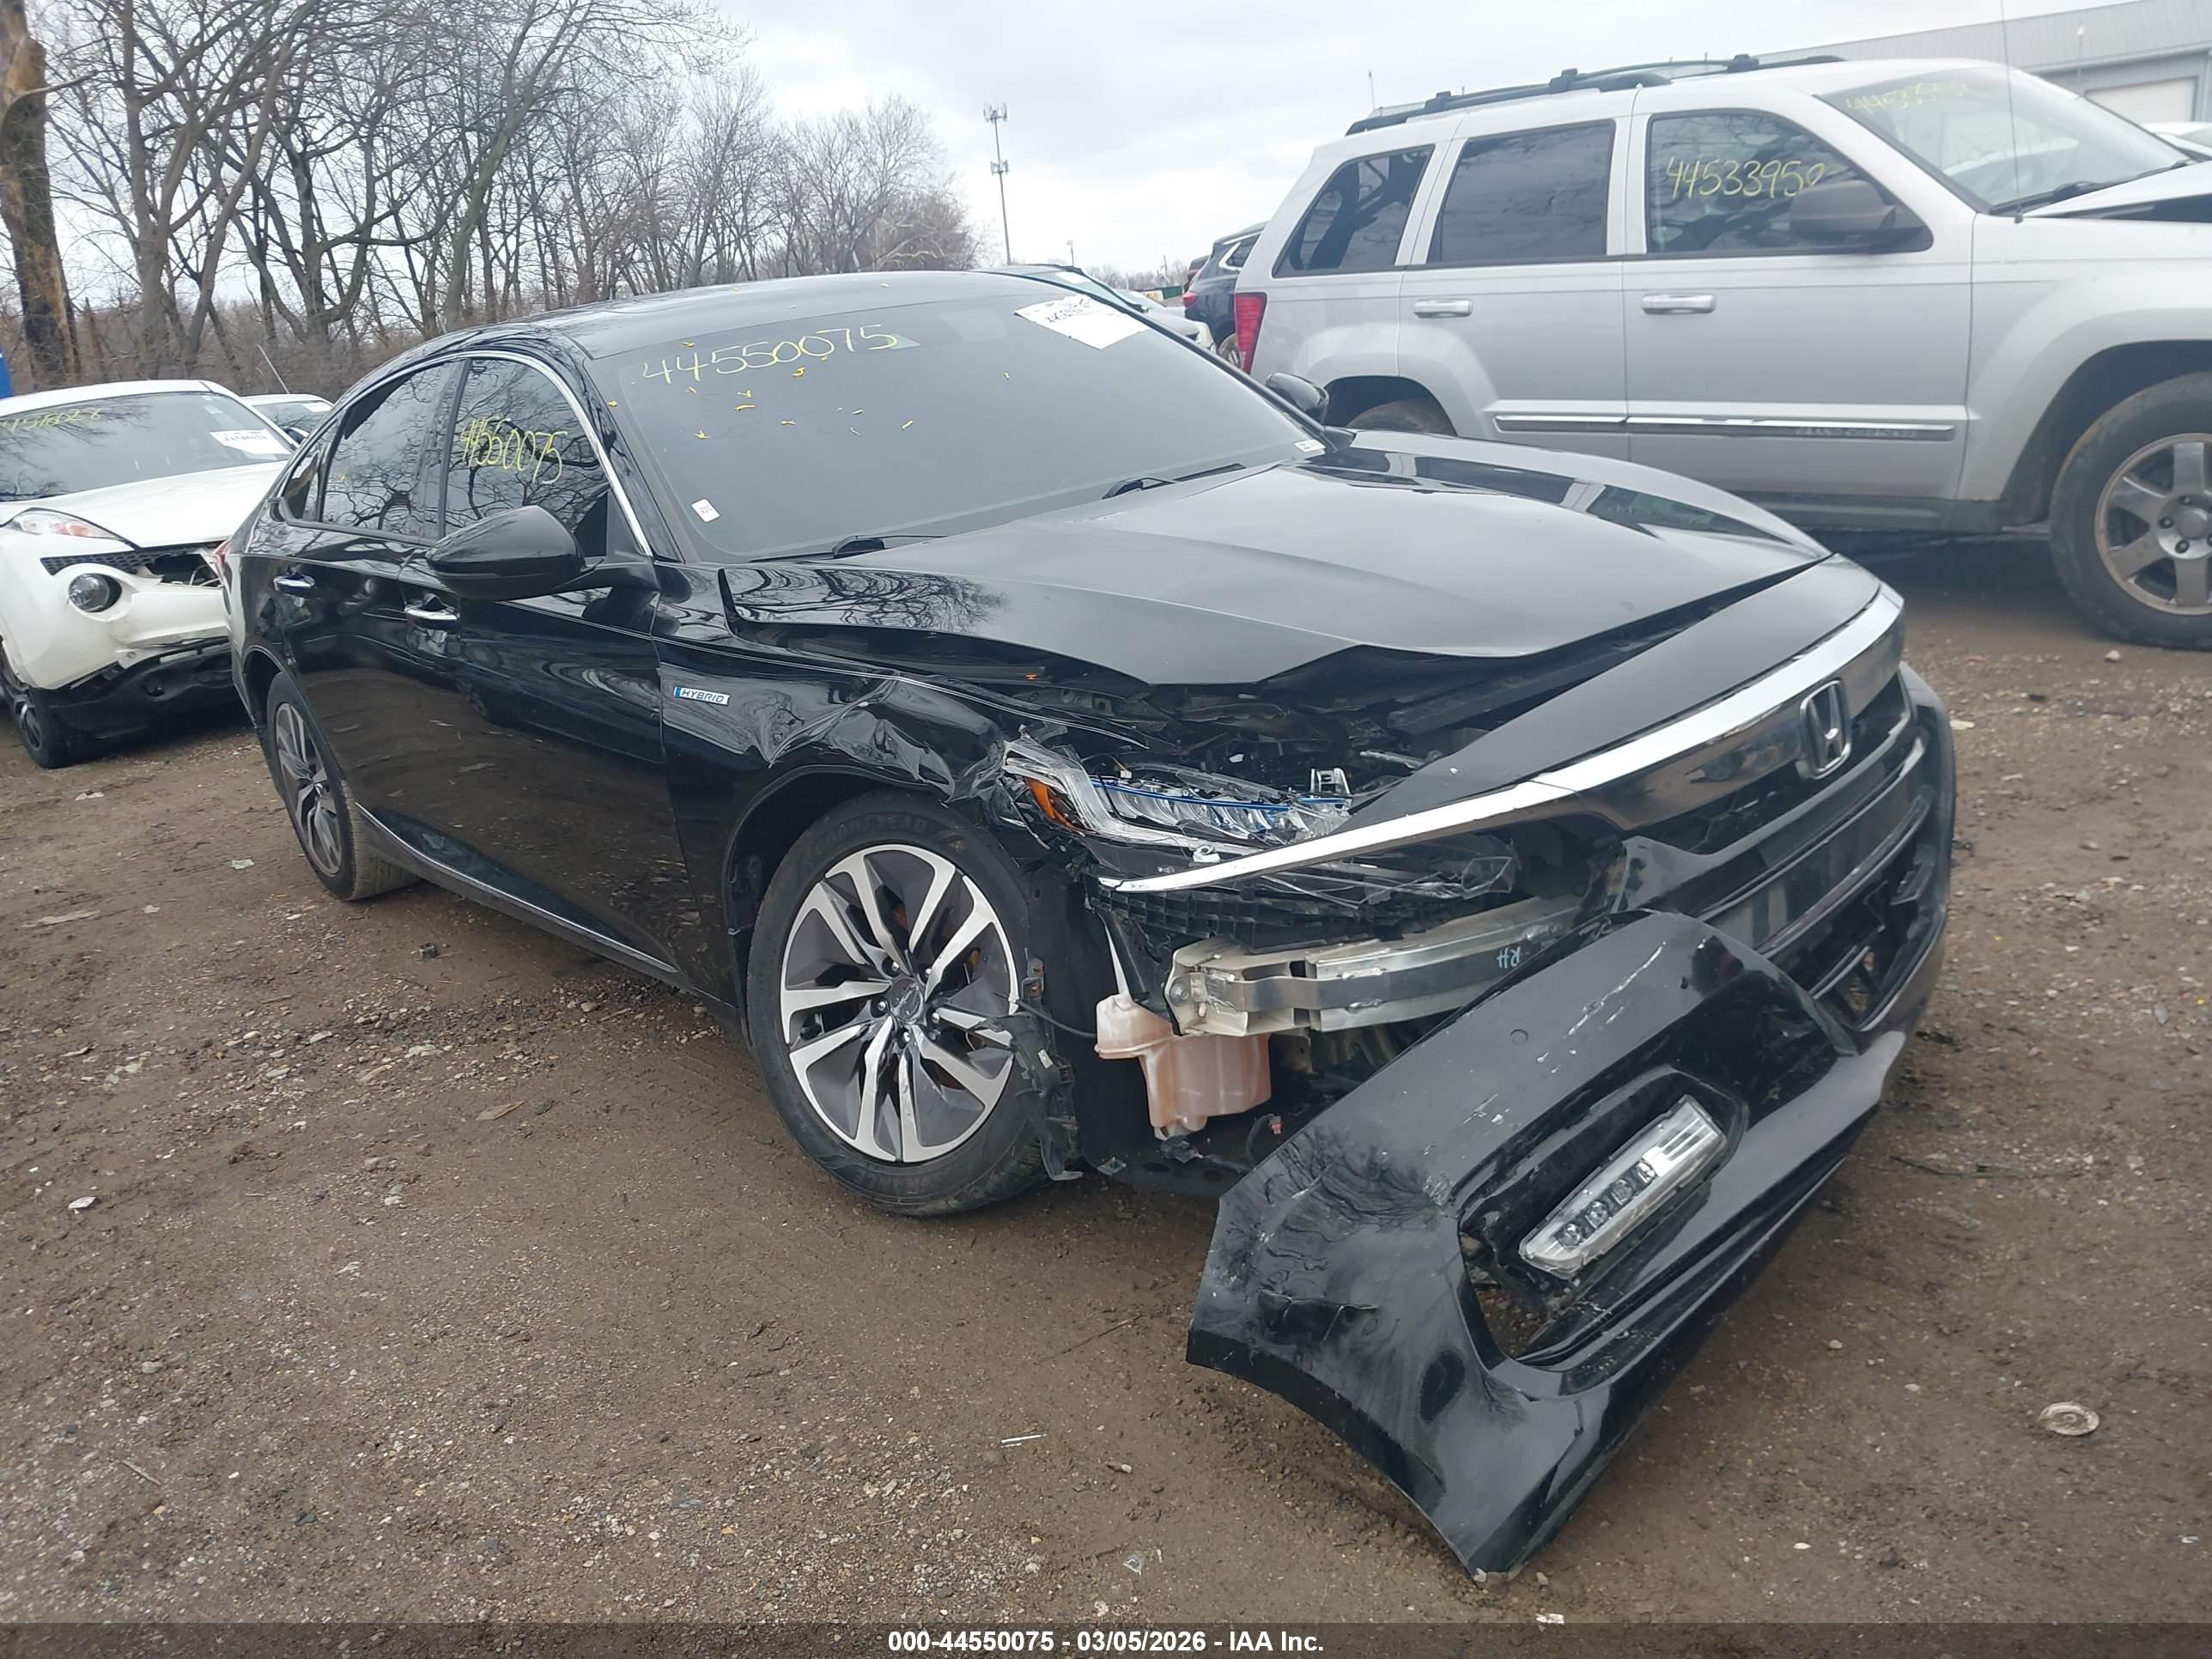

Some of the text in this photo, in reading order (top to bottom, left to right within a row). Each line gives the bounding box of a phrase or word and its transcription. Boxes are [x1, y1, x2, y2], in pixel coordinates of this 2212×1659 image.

[1666, 157, 1826, 199] 44533950
[643, 324, 898, 384] 44550075
[460, 416, 568, 484] 44550075
[681, 689, 725, 703] HYBRID
